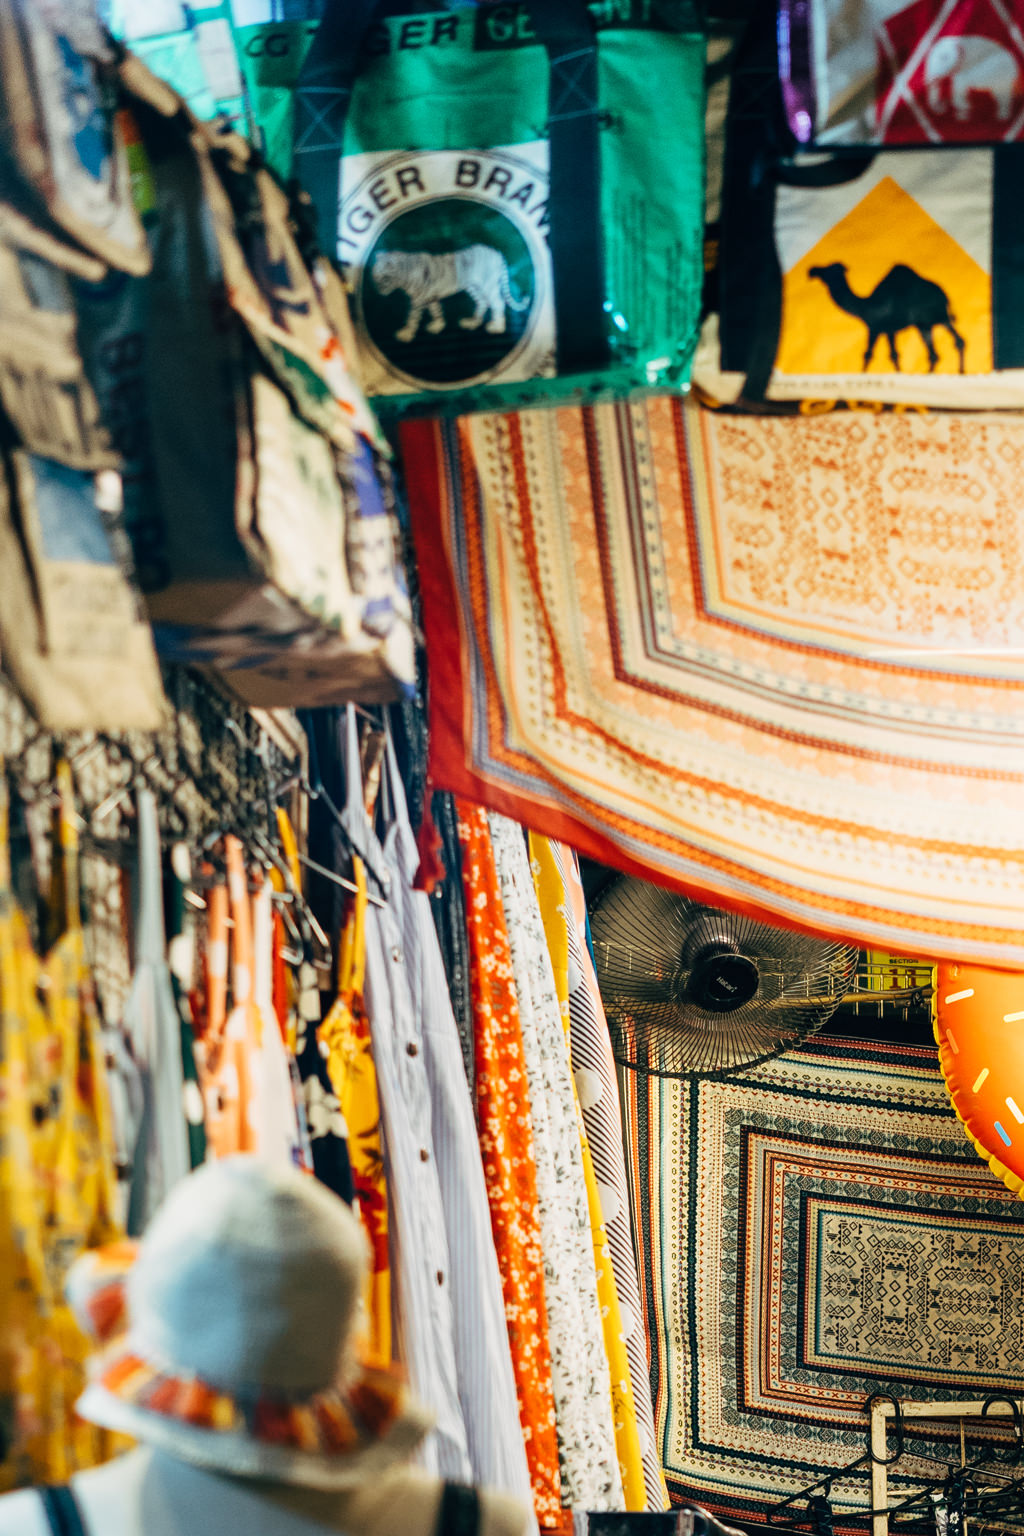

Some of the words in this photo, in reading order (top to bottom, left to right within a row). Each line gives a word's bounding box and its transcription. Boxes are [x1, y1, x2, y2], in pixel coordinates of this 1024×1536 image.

[337, 166, 426, 268] IGER
[454, 159, 551, 240] BRAN
[889, 968, 917, 989] 11
